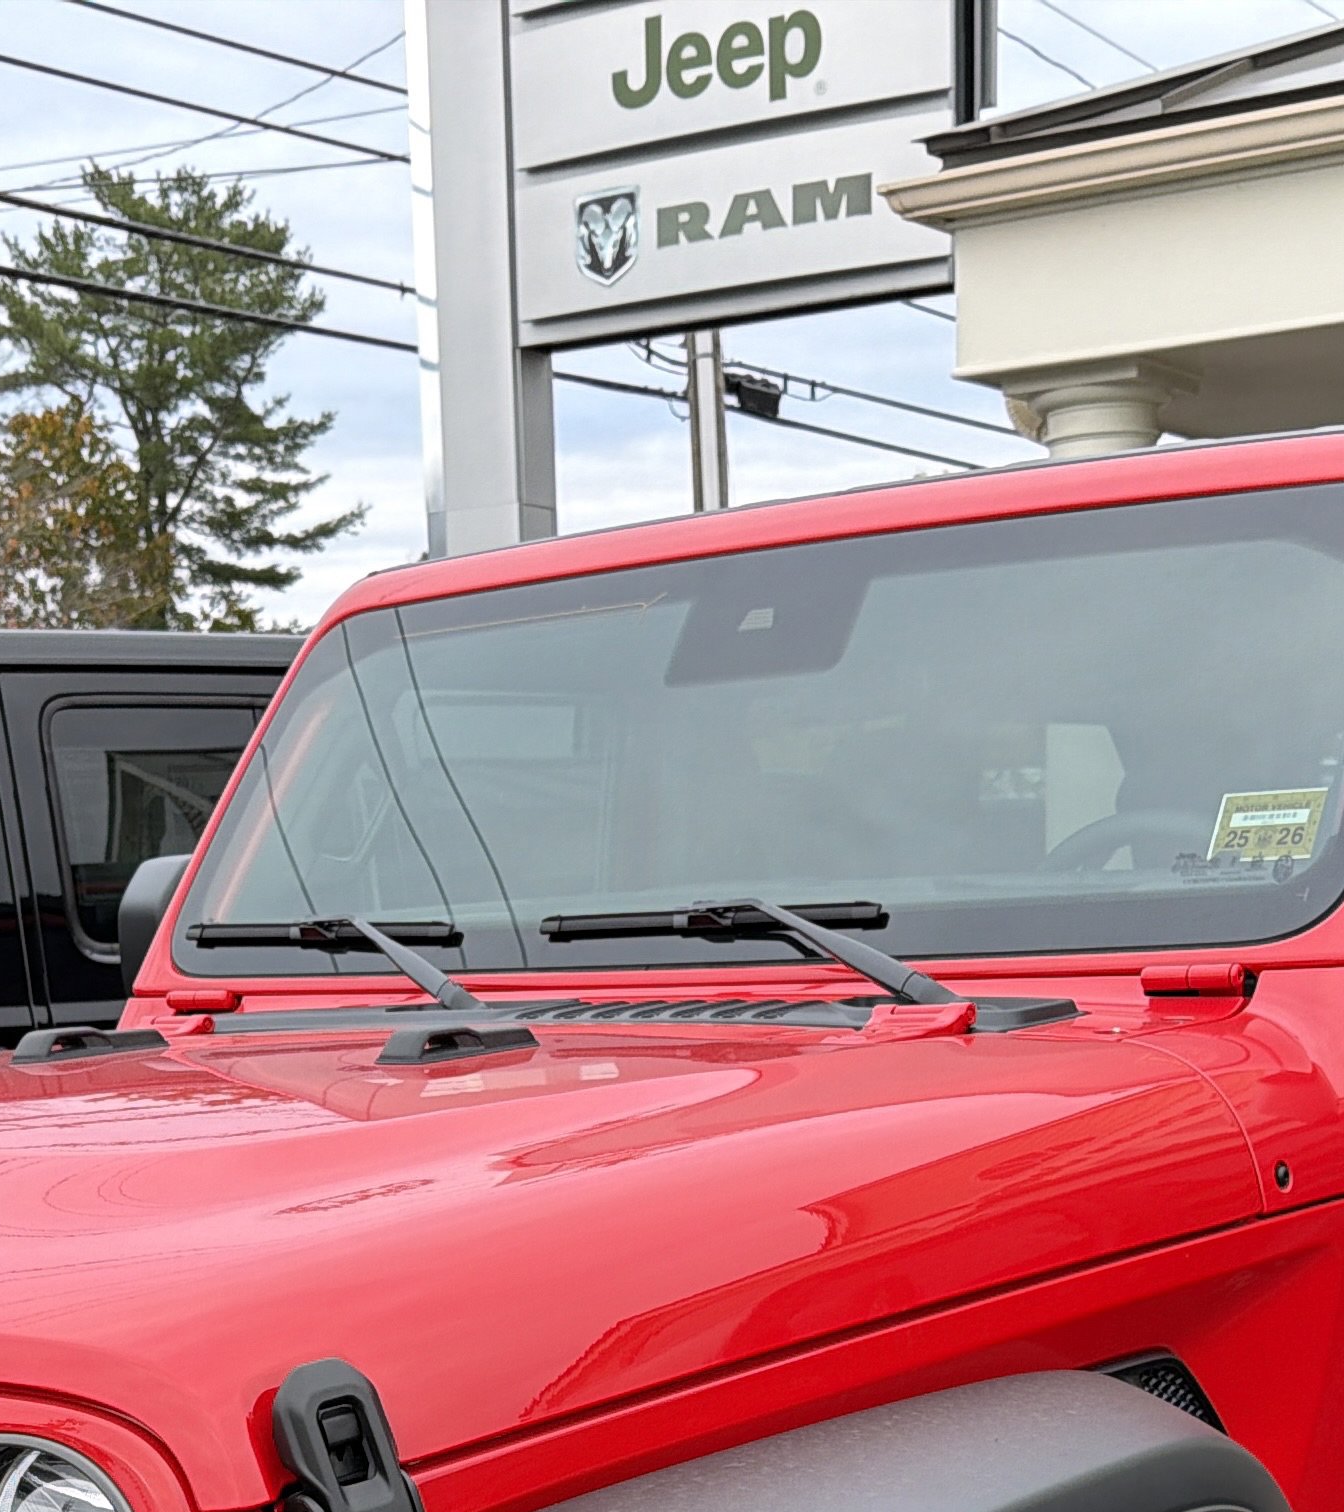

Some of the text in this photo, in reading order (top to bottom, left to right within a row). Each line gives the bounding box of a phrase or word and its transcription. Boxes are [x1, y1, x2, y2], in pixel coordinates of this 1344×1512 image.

[611, 9, 822, 109] Jeep
[656, 172, 873, 249] RAM
[1224, 825, 1305, 848] 25 26
